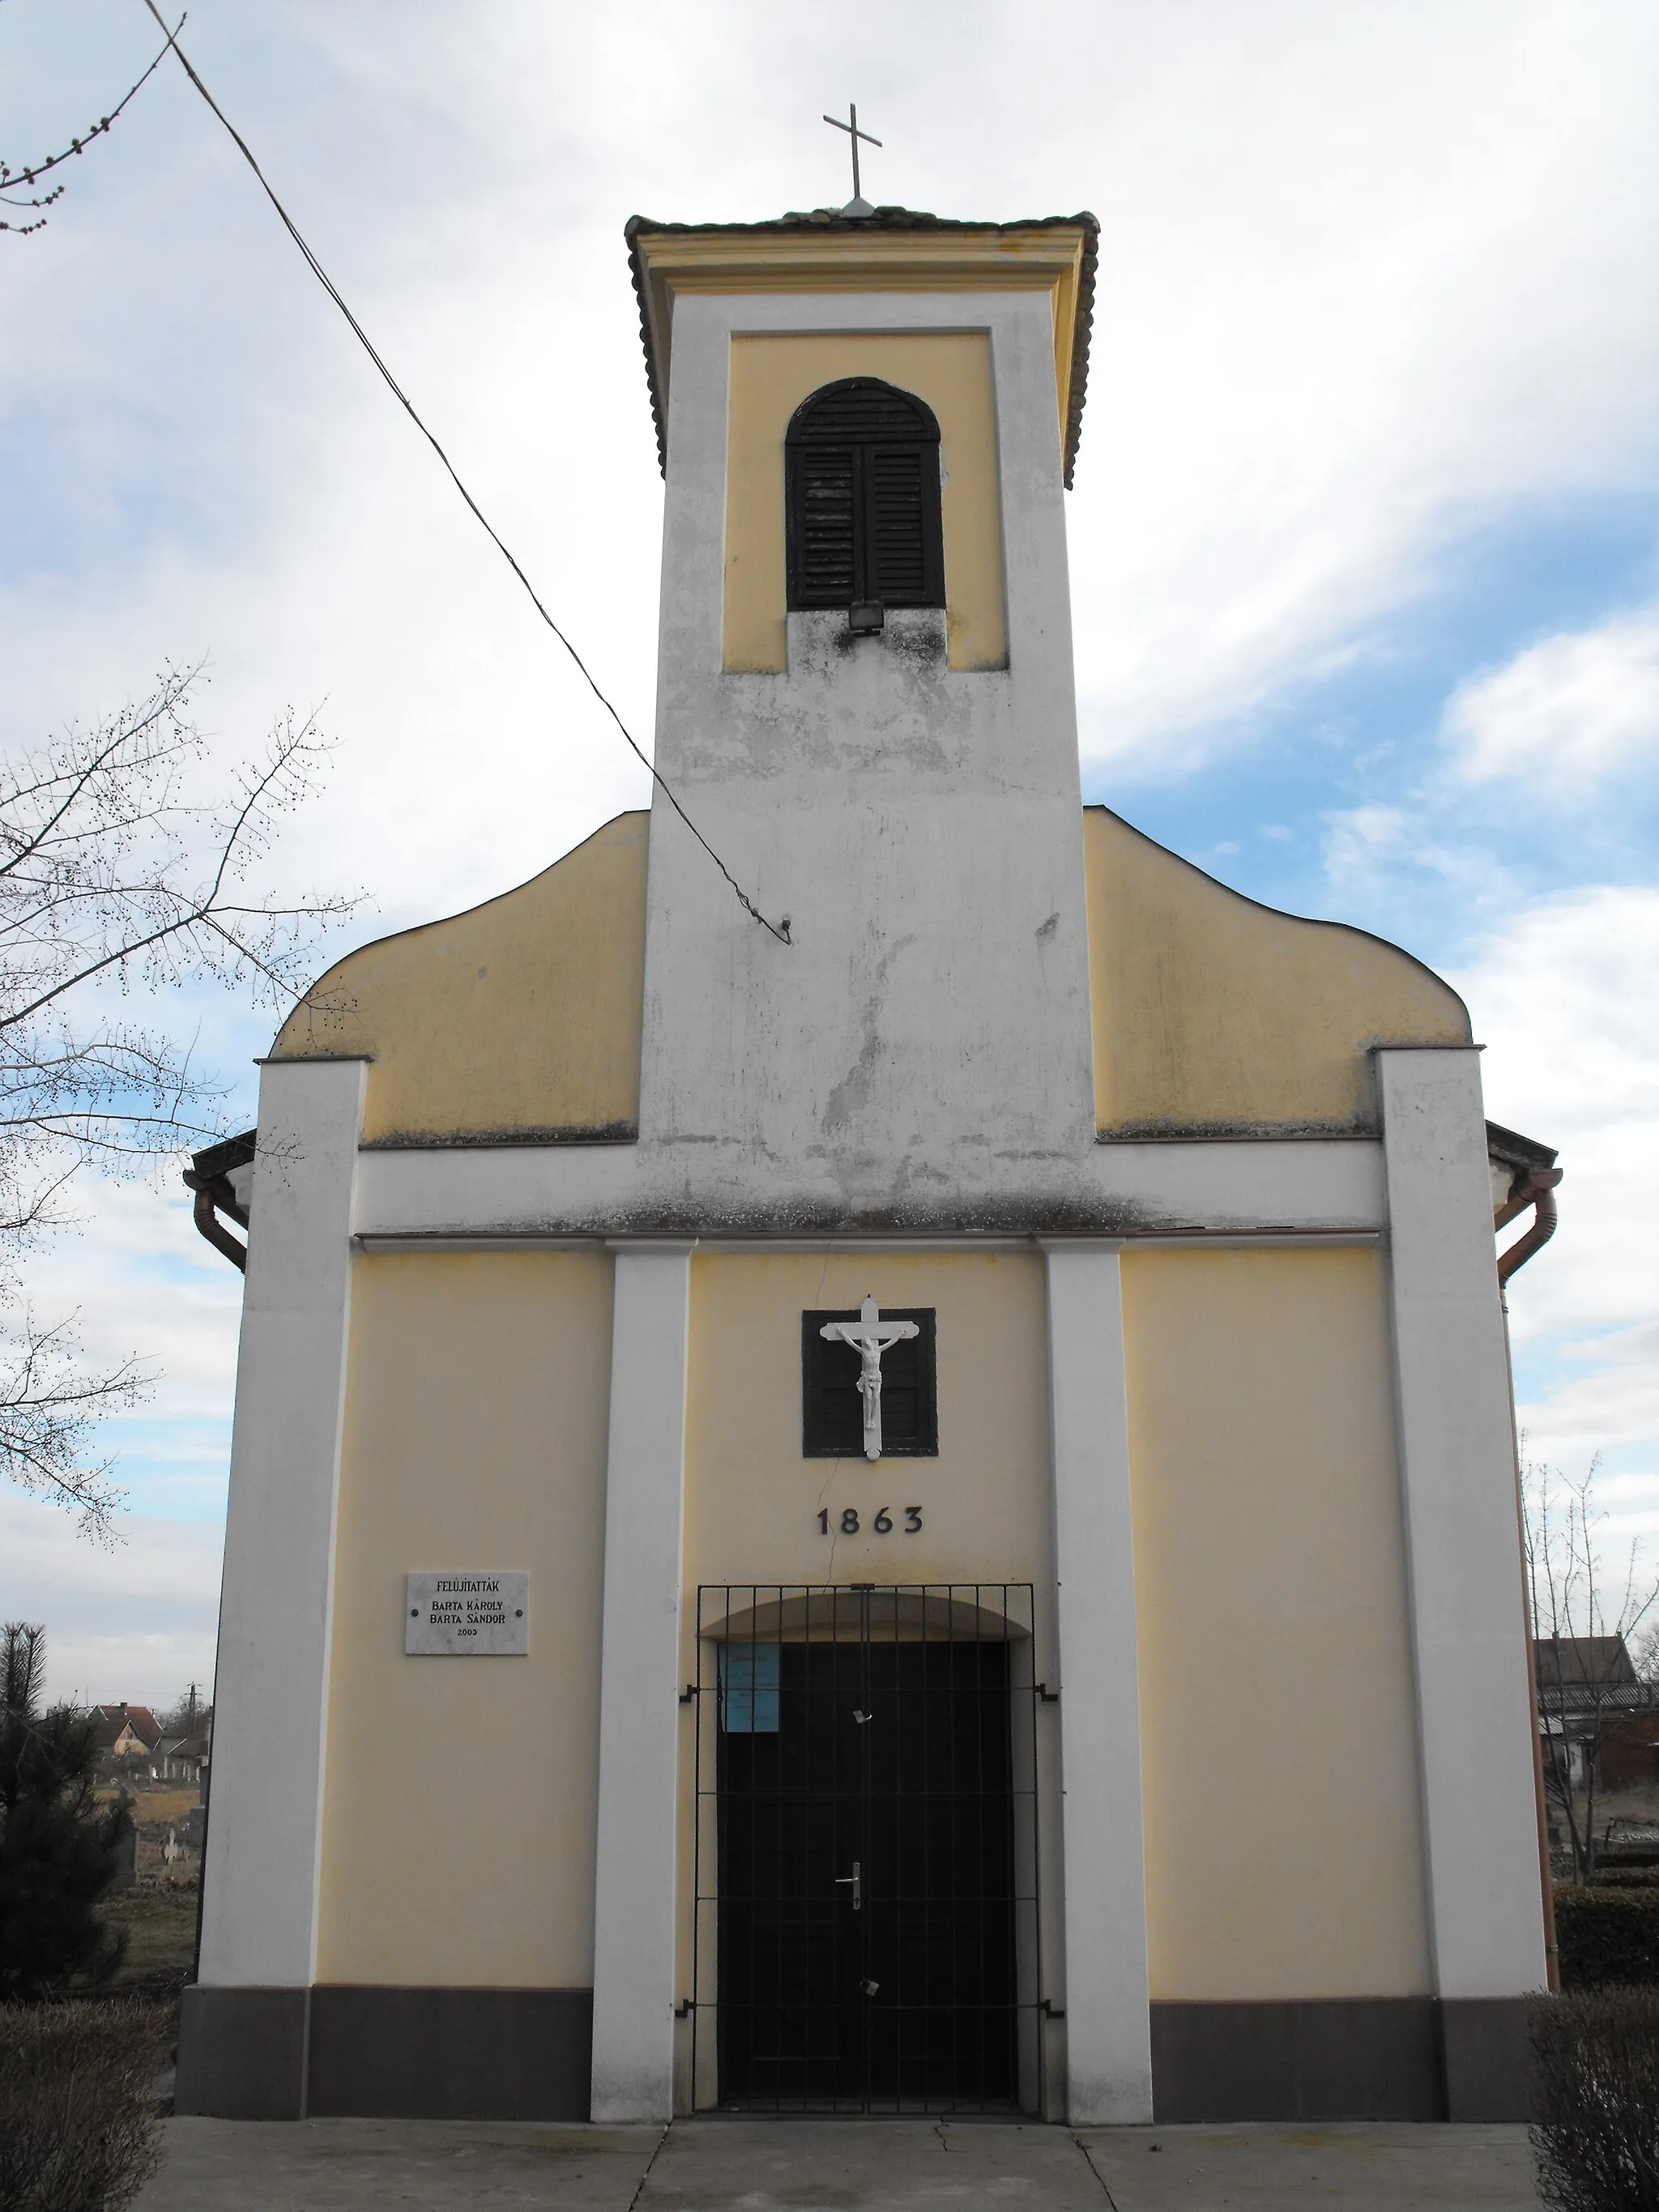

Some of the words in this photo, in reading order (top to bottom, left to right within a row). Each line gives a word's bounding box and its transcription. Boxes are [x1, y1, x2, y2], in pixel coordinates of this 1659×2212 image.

[817, 1506, 923, 1535] 1863
[437, 1577, 500, 1592] FELÚJÍTATTÁK
[432, 1600, 463, 1611] BARTA
[467, 1598, 503, 1611] KÁROLY
[429, 1614, 462, 1624] BARTA
[467, 1612, 505, 1624] SÁNDOR
